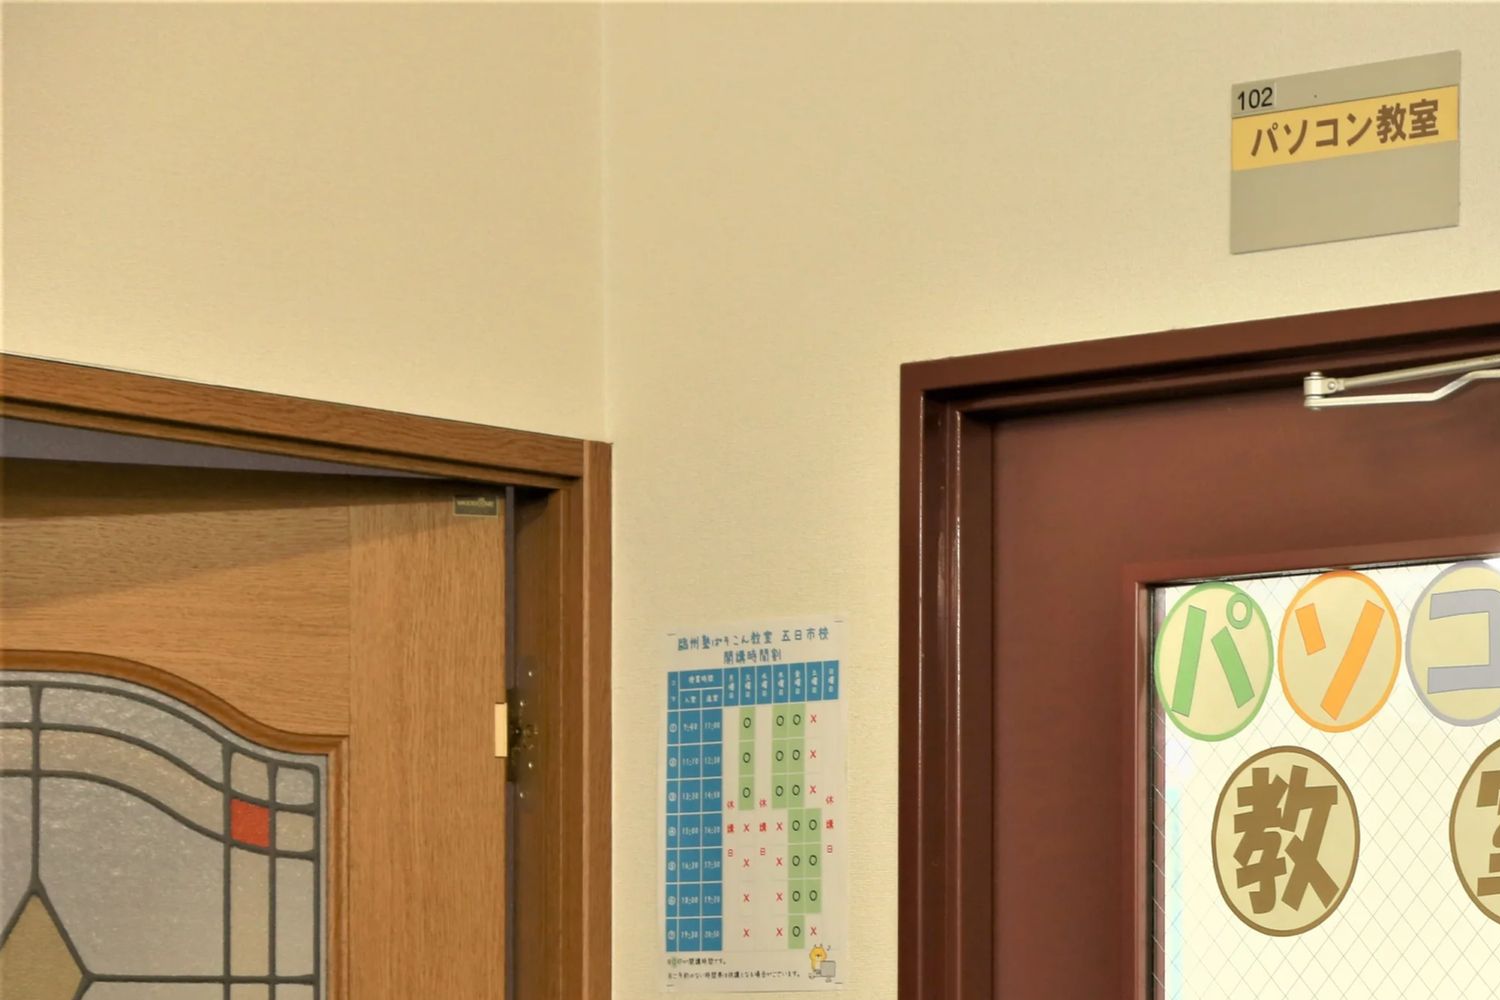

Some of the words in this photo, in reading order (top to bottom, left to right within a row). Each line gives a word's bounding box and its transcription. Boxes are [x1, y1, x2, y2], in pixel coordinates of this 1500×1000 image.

[1237, 87, 1273, 110] 102
[1251, 98, 1439, 157] パソコン教室
